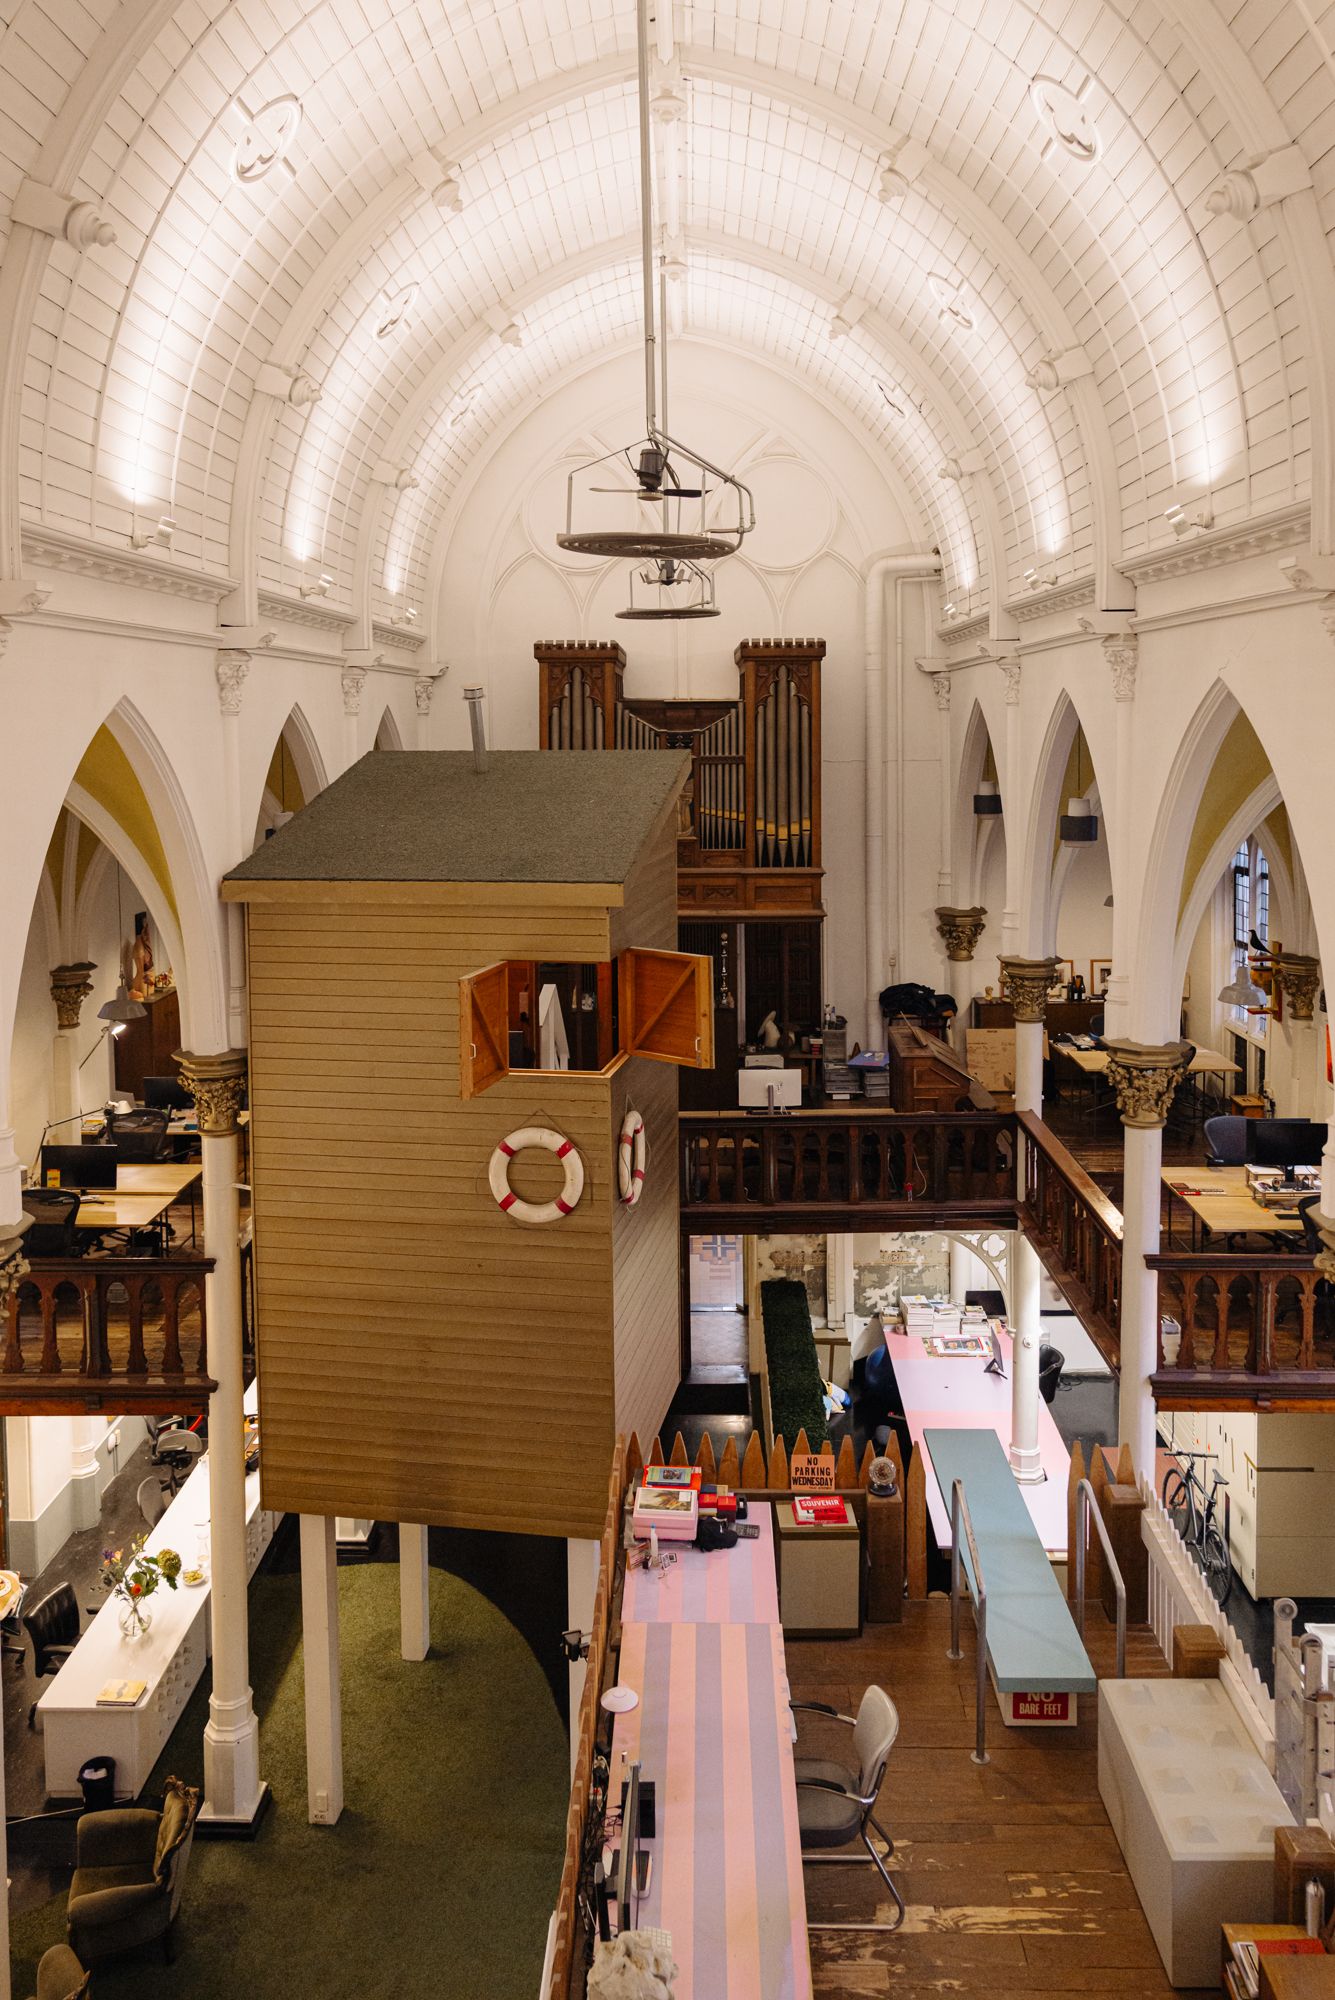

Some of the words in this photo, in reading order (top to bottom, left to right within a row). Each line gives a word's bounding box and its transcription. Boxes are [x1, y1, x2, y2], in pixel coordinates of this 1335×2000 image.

[807, 1457, 818, 1466] NO
[795, 1467, 831, 1476] PARKING
[792, 1477, 833, 1486] WEDNESDAY
[801, 1499, 839, 1507] SOUVENIR
[1027, 1692, 1055, 1702] NO
[1019, 1703, 1040, 1715] BARE
[1043, 1703, 1062, 1715] FEET
